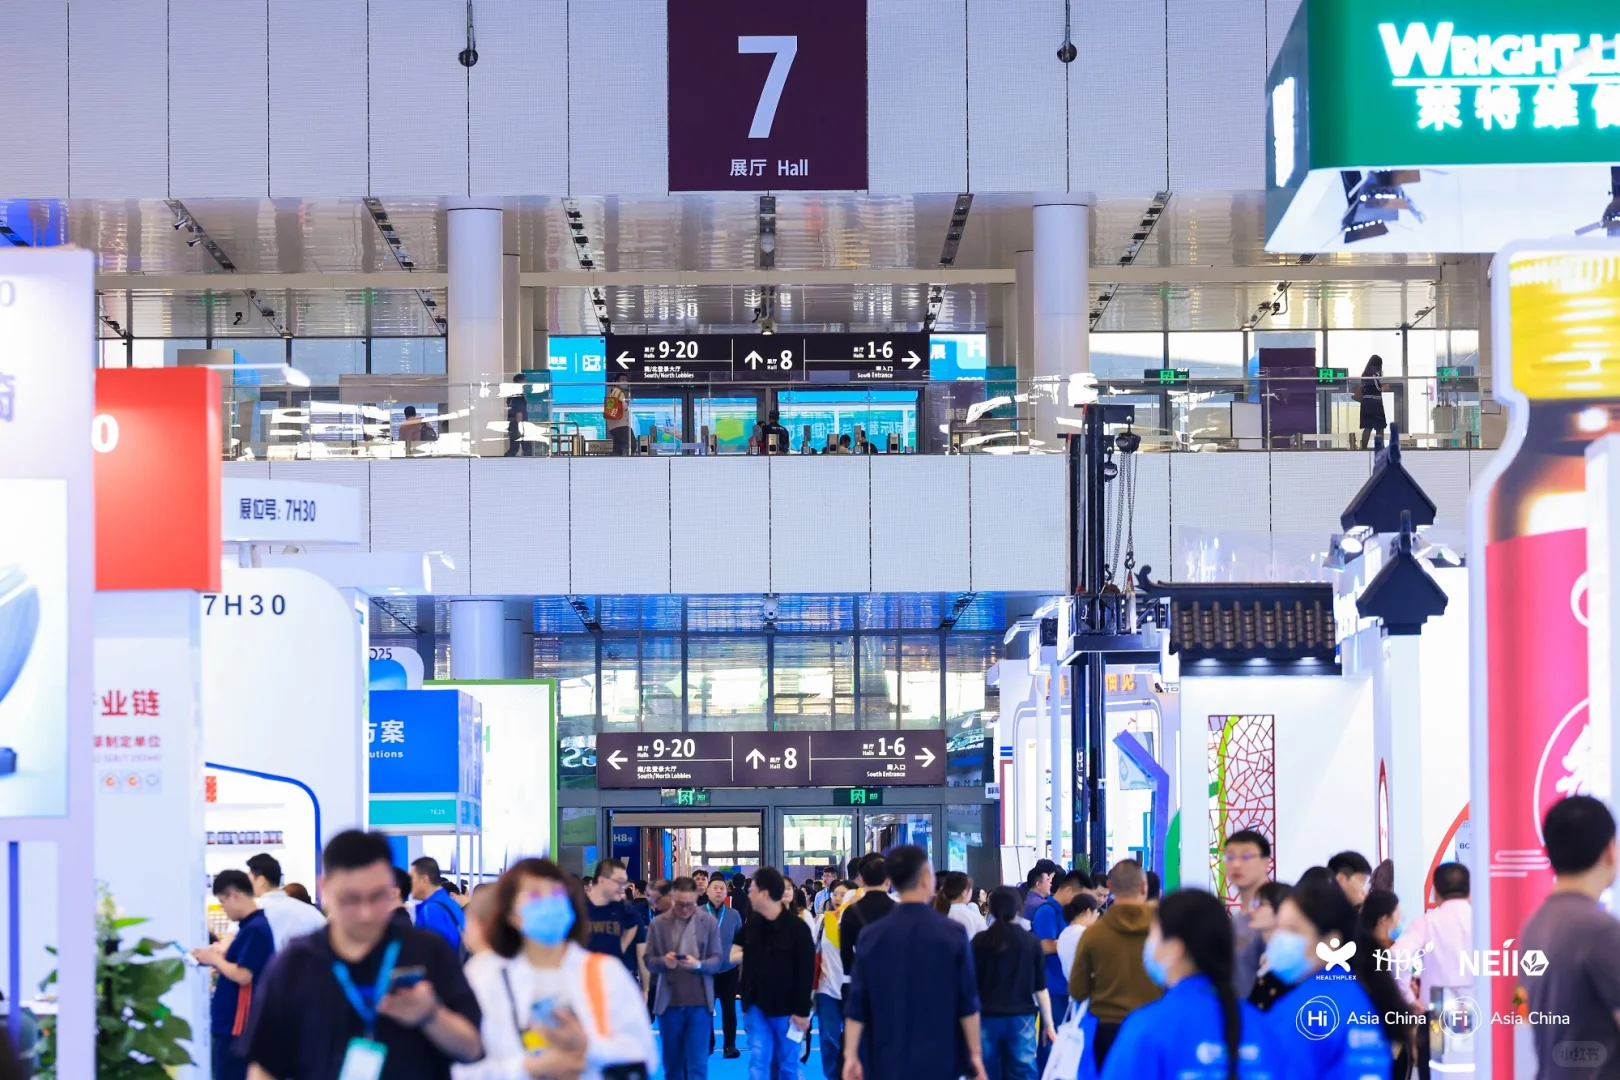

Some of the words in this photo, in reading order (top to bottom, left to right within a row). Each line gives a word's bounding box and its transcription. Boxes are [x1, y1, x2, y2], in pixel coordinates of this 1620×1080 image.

[738, 36, 797, 138] 7
[729, 159, 767, 177] 展厅
[777, 159, 809, 176] Hall
[658, 340, 698, 359] 9-20
[867, 340, 893, 359] 1-6
[780, 350, 792, 370] 8
[285, 500, 316, 522] 7H30
[203, 595, 286, 616] 7H30
[93, 690, 159, 716] 业链
[653, 738, 696, 758] 9-20
[878, 737, 906, 756] 1-6
[784, 747, 797, 769] 8
